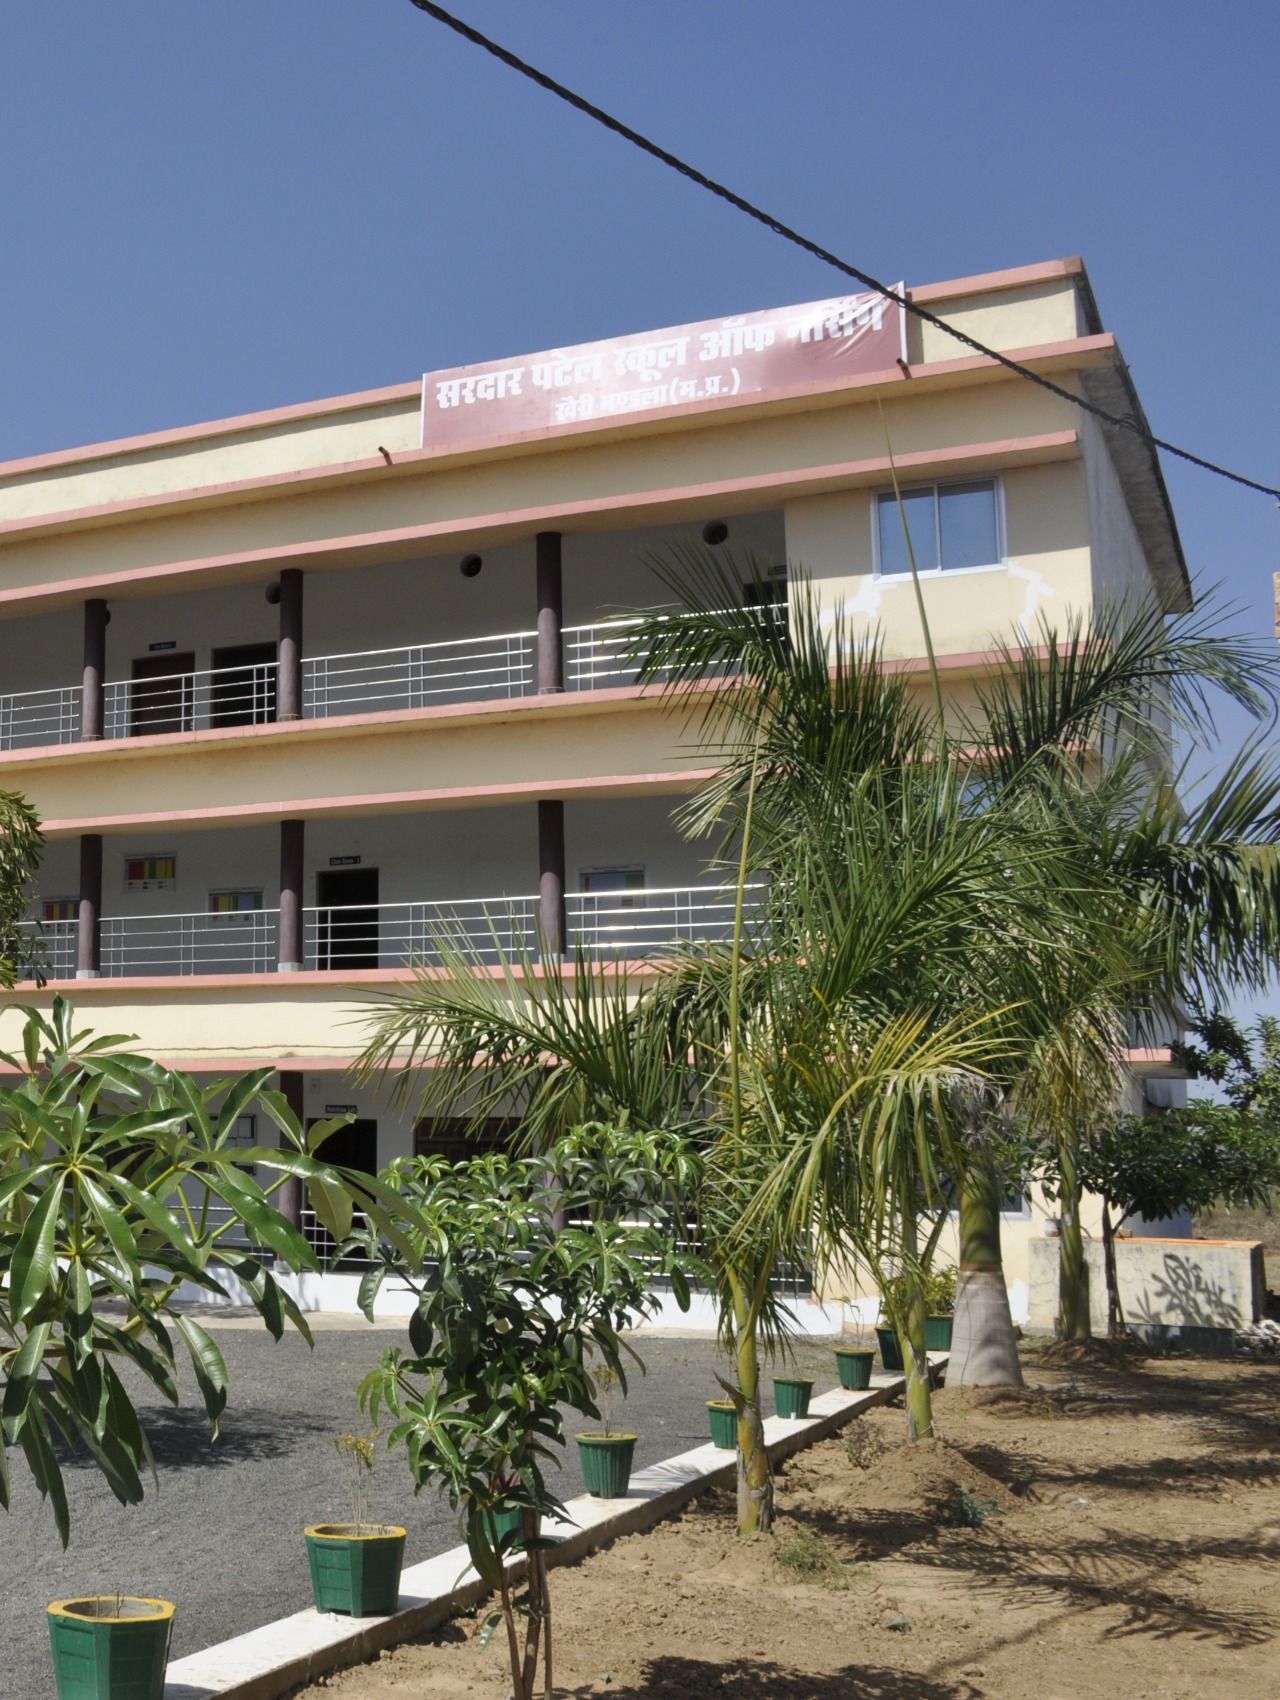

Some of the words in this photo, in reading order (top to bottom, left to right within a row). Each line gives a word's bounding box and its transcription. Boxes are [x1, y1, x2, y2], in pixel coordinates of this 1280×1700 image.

[436, 367, 525, 409] सरदार
[531, 351, 605, 391] पटेल
[613, 336, 691, 383] स्कूल
[699, 317, 777, 361] ऑफ
